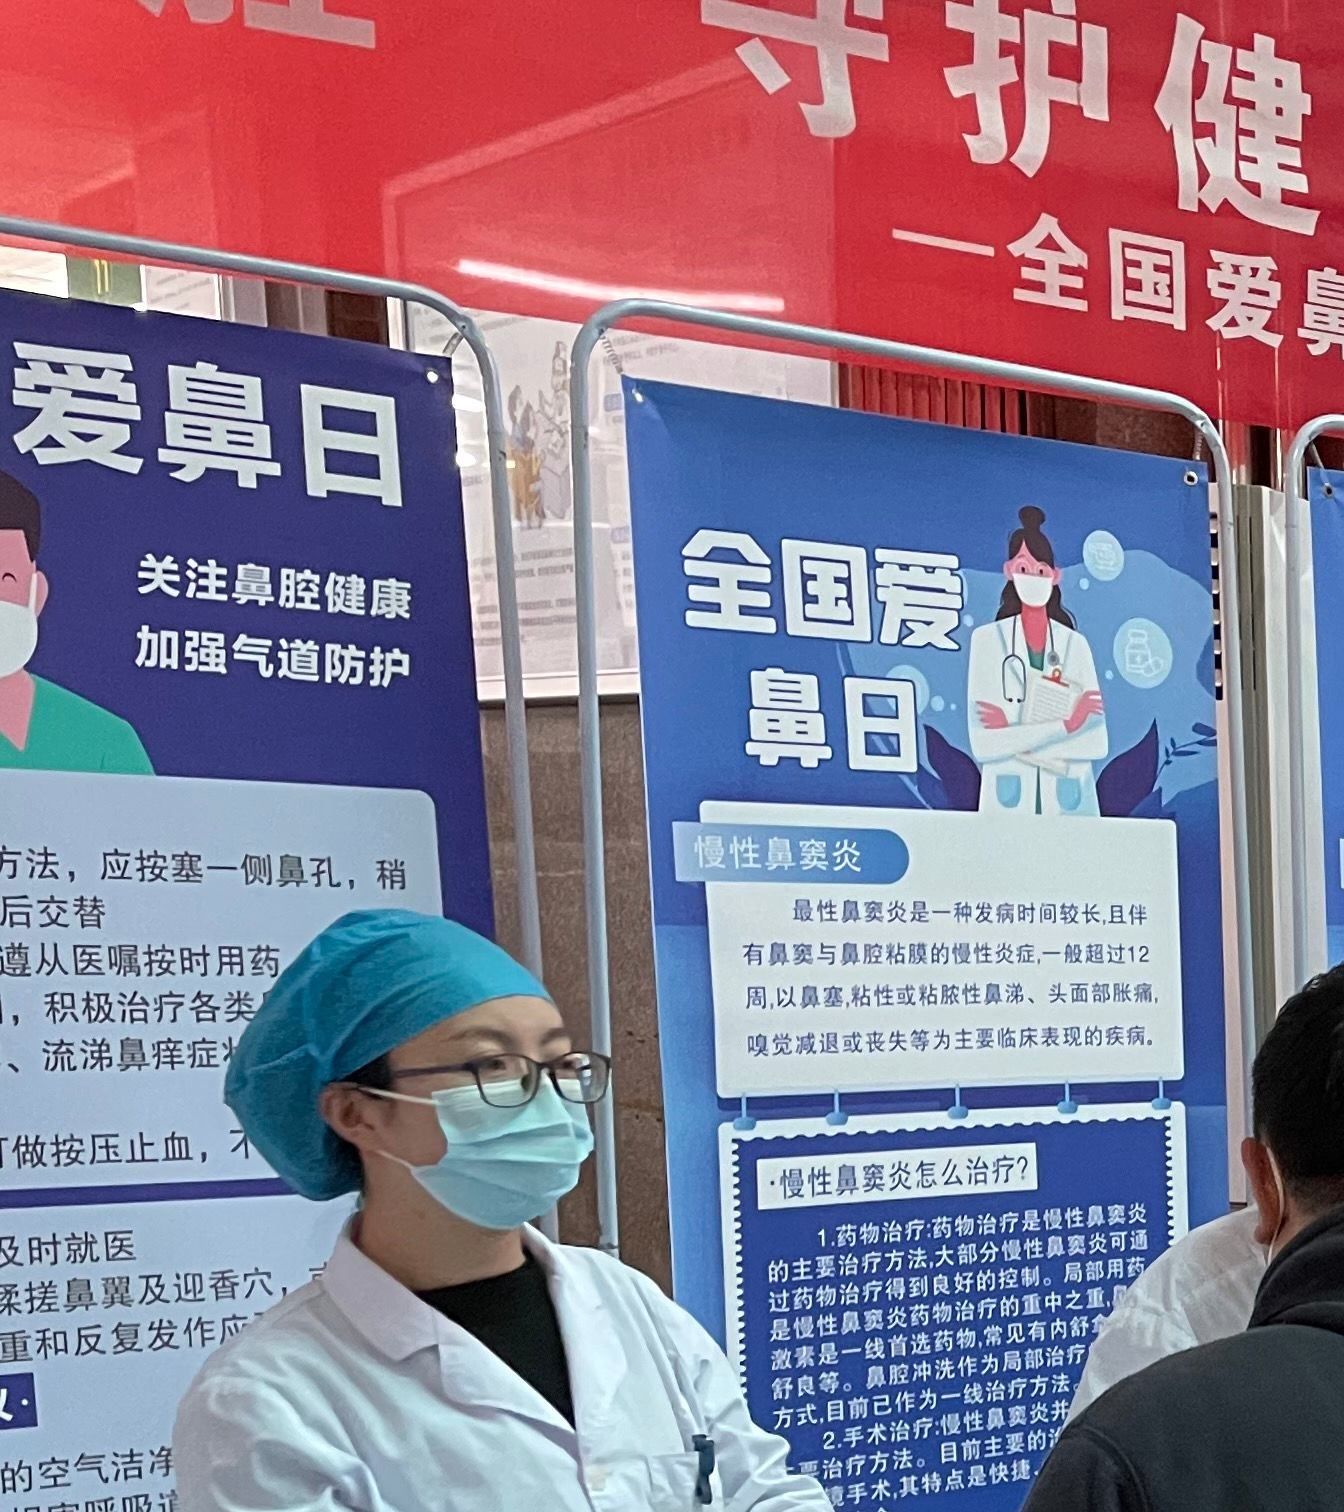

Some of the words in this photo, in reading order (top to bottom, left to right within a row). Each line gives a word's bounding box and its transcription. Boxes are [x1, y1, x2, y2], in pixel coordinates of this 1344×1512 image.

[136, 553, 412, 622] 关注鼻腔健康
[681, 528, 963, 652] 全国爱
[134, 625, 411, 690] 加强气道防护
[745, 667, 919, 774] 鼻日
[693, 835, 862, 873] 慢性鼻窦炎
[0, 941, 281, 979] 遵从医嘱按时用药
[0, 990, 270, 1032] ，积极治疗各类
[0, 1038, 236, 1073] 、流涕鼻痒症
[0, 1131, 250, 1169] 做按压止血，不
[0, 1230, 137, 1268] 及时就医
[768, 1229, 1149, 1284] 的主要治疗方法,大部分慢性鼻窦炎可通
[0, 1266, 326, 1316] 揉搓鼻翼及迎香穴，
[769, 1256, 1146, 1313] 过药物治疗得到良好的控制。局部用药
